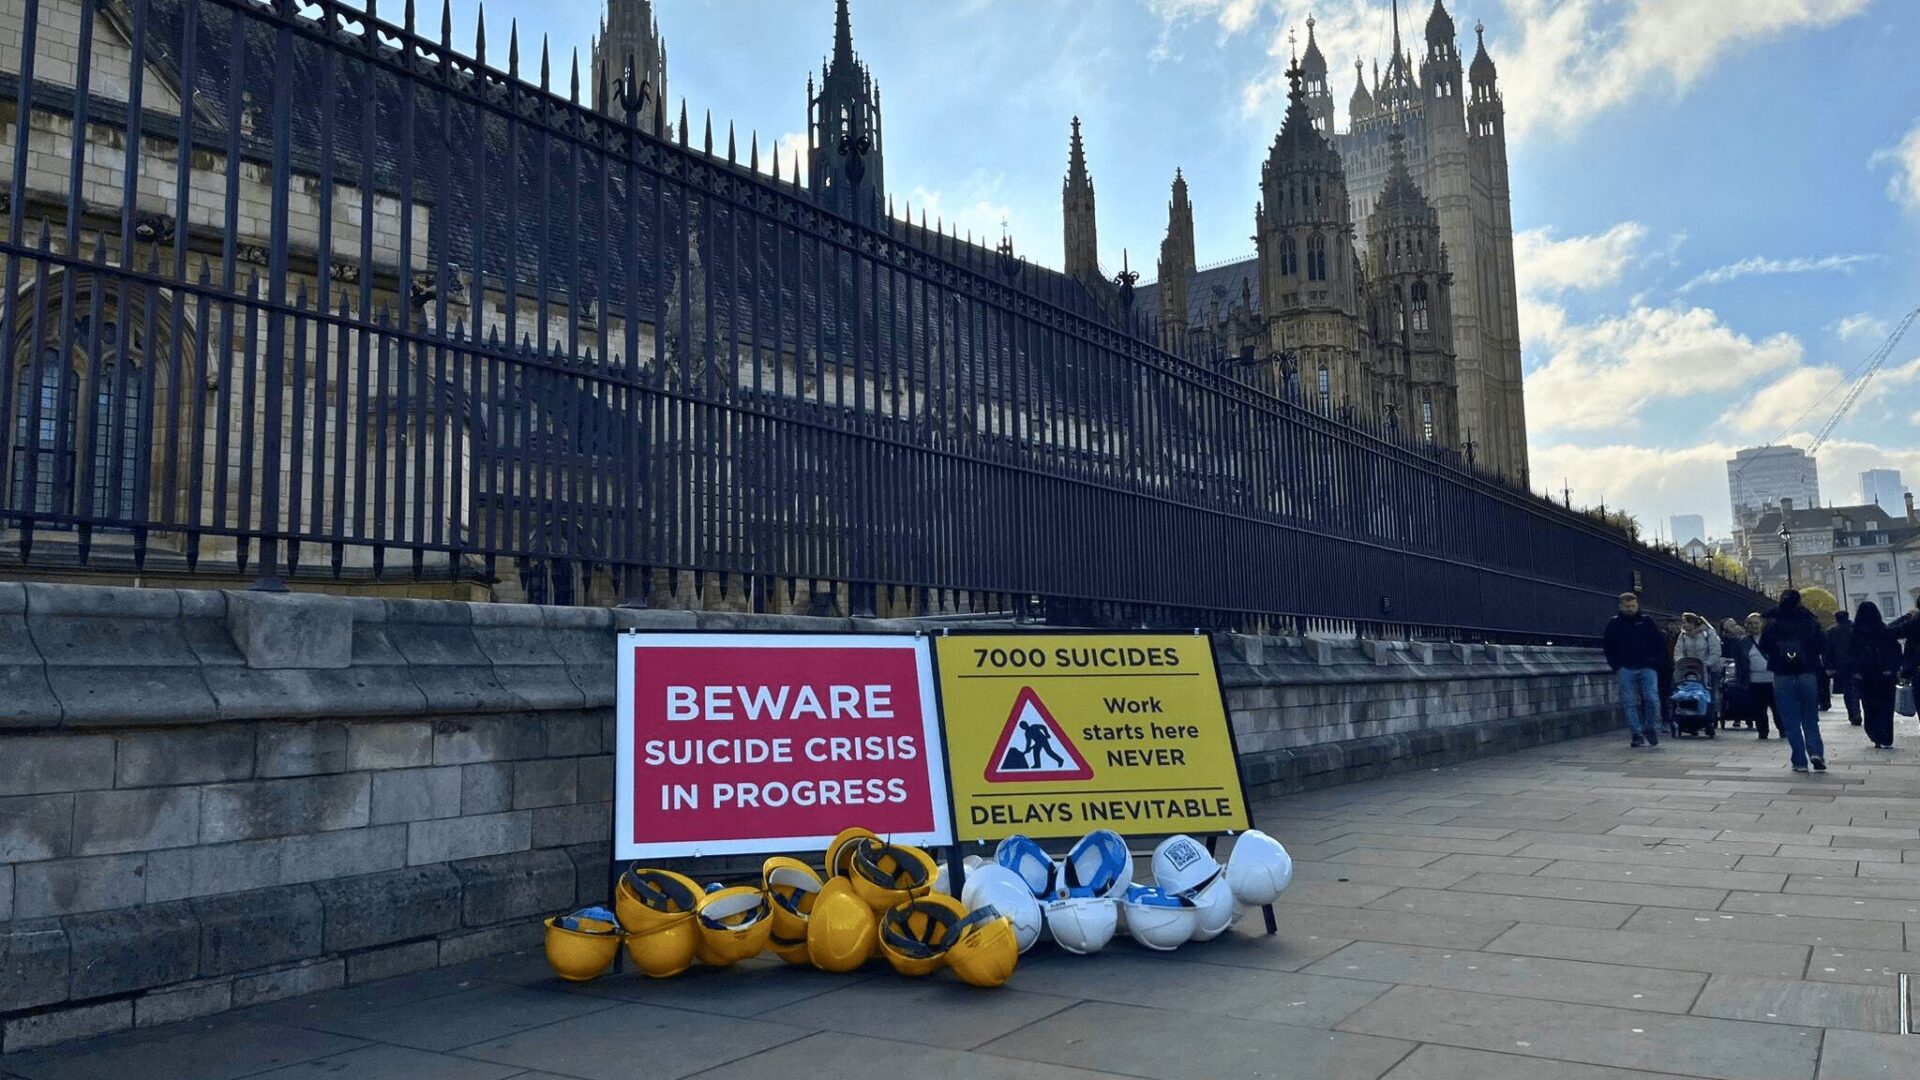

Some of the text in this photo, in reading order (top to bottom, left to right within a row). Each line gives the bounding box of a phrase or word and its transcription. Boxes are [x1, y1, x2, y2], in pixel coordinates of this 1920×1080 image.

[973, 647, 1180, 668] 7000 SUICIDES
[667, 684, 895, 721] BEWARE
[1102, 696, 1163, 714] Work
[1082, 721, 1200, 741] starts here
[644, 735, 917, 766] SUICIDE CRISIS
[1107, 748, 1186, 767] NEVER
[661, 778, 907, 810] IN PROGRESS
[970, 797, 1233, 825] DELAYS INEVITABLE
